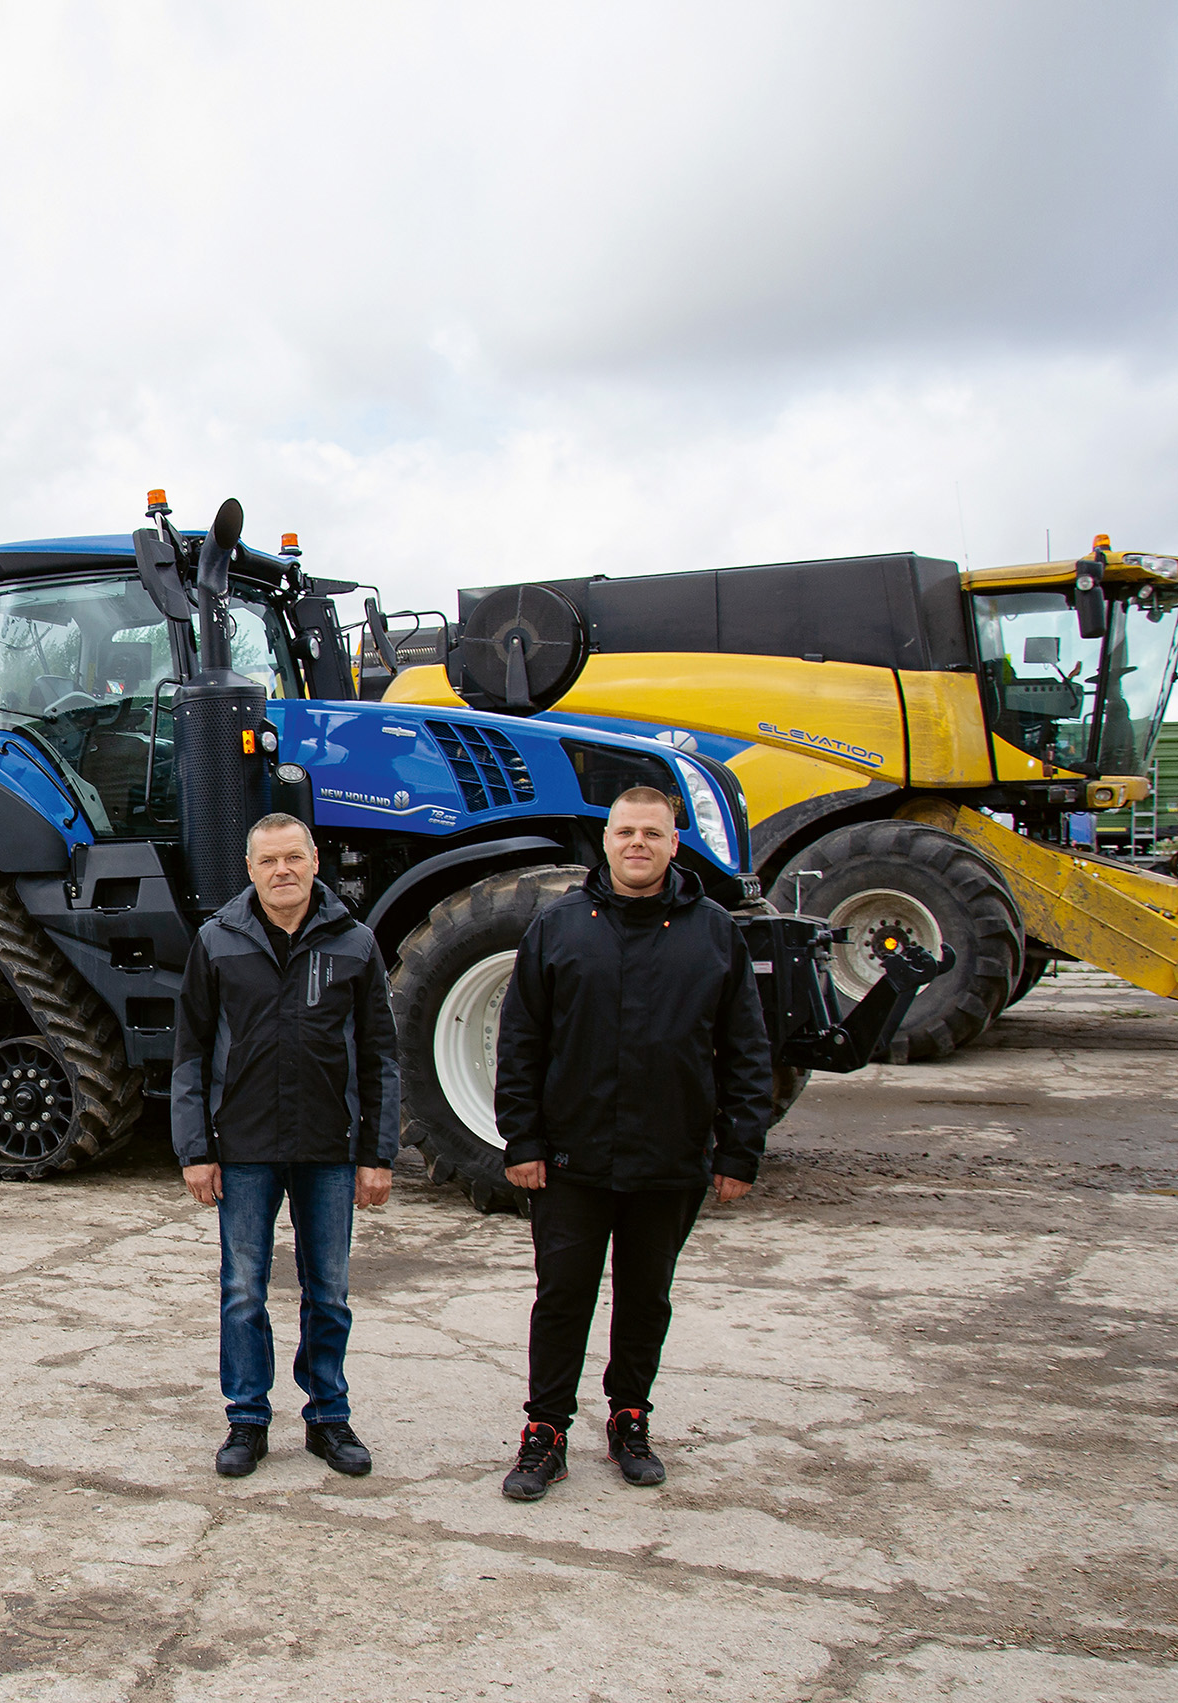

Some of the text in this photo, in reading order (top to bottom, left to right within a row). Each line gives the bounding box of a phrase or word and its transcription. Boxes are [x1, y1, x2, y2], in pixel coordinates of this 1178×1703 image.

[758, 721, 885, 764] ELEVATION
[320, 787, 391, 807] NEW HOLLAND
